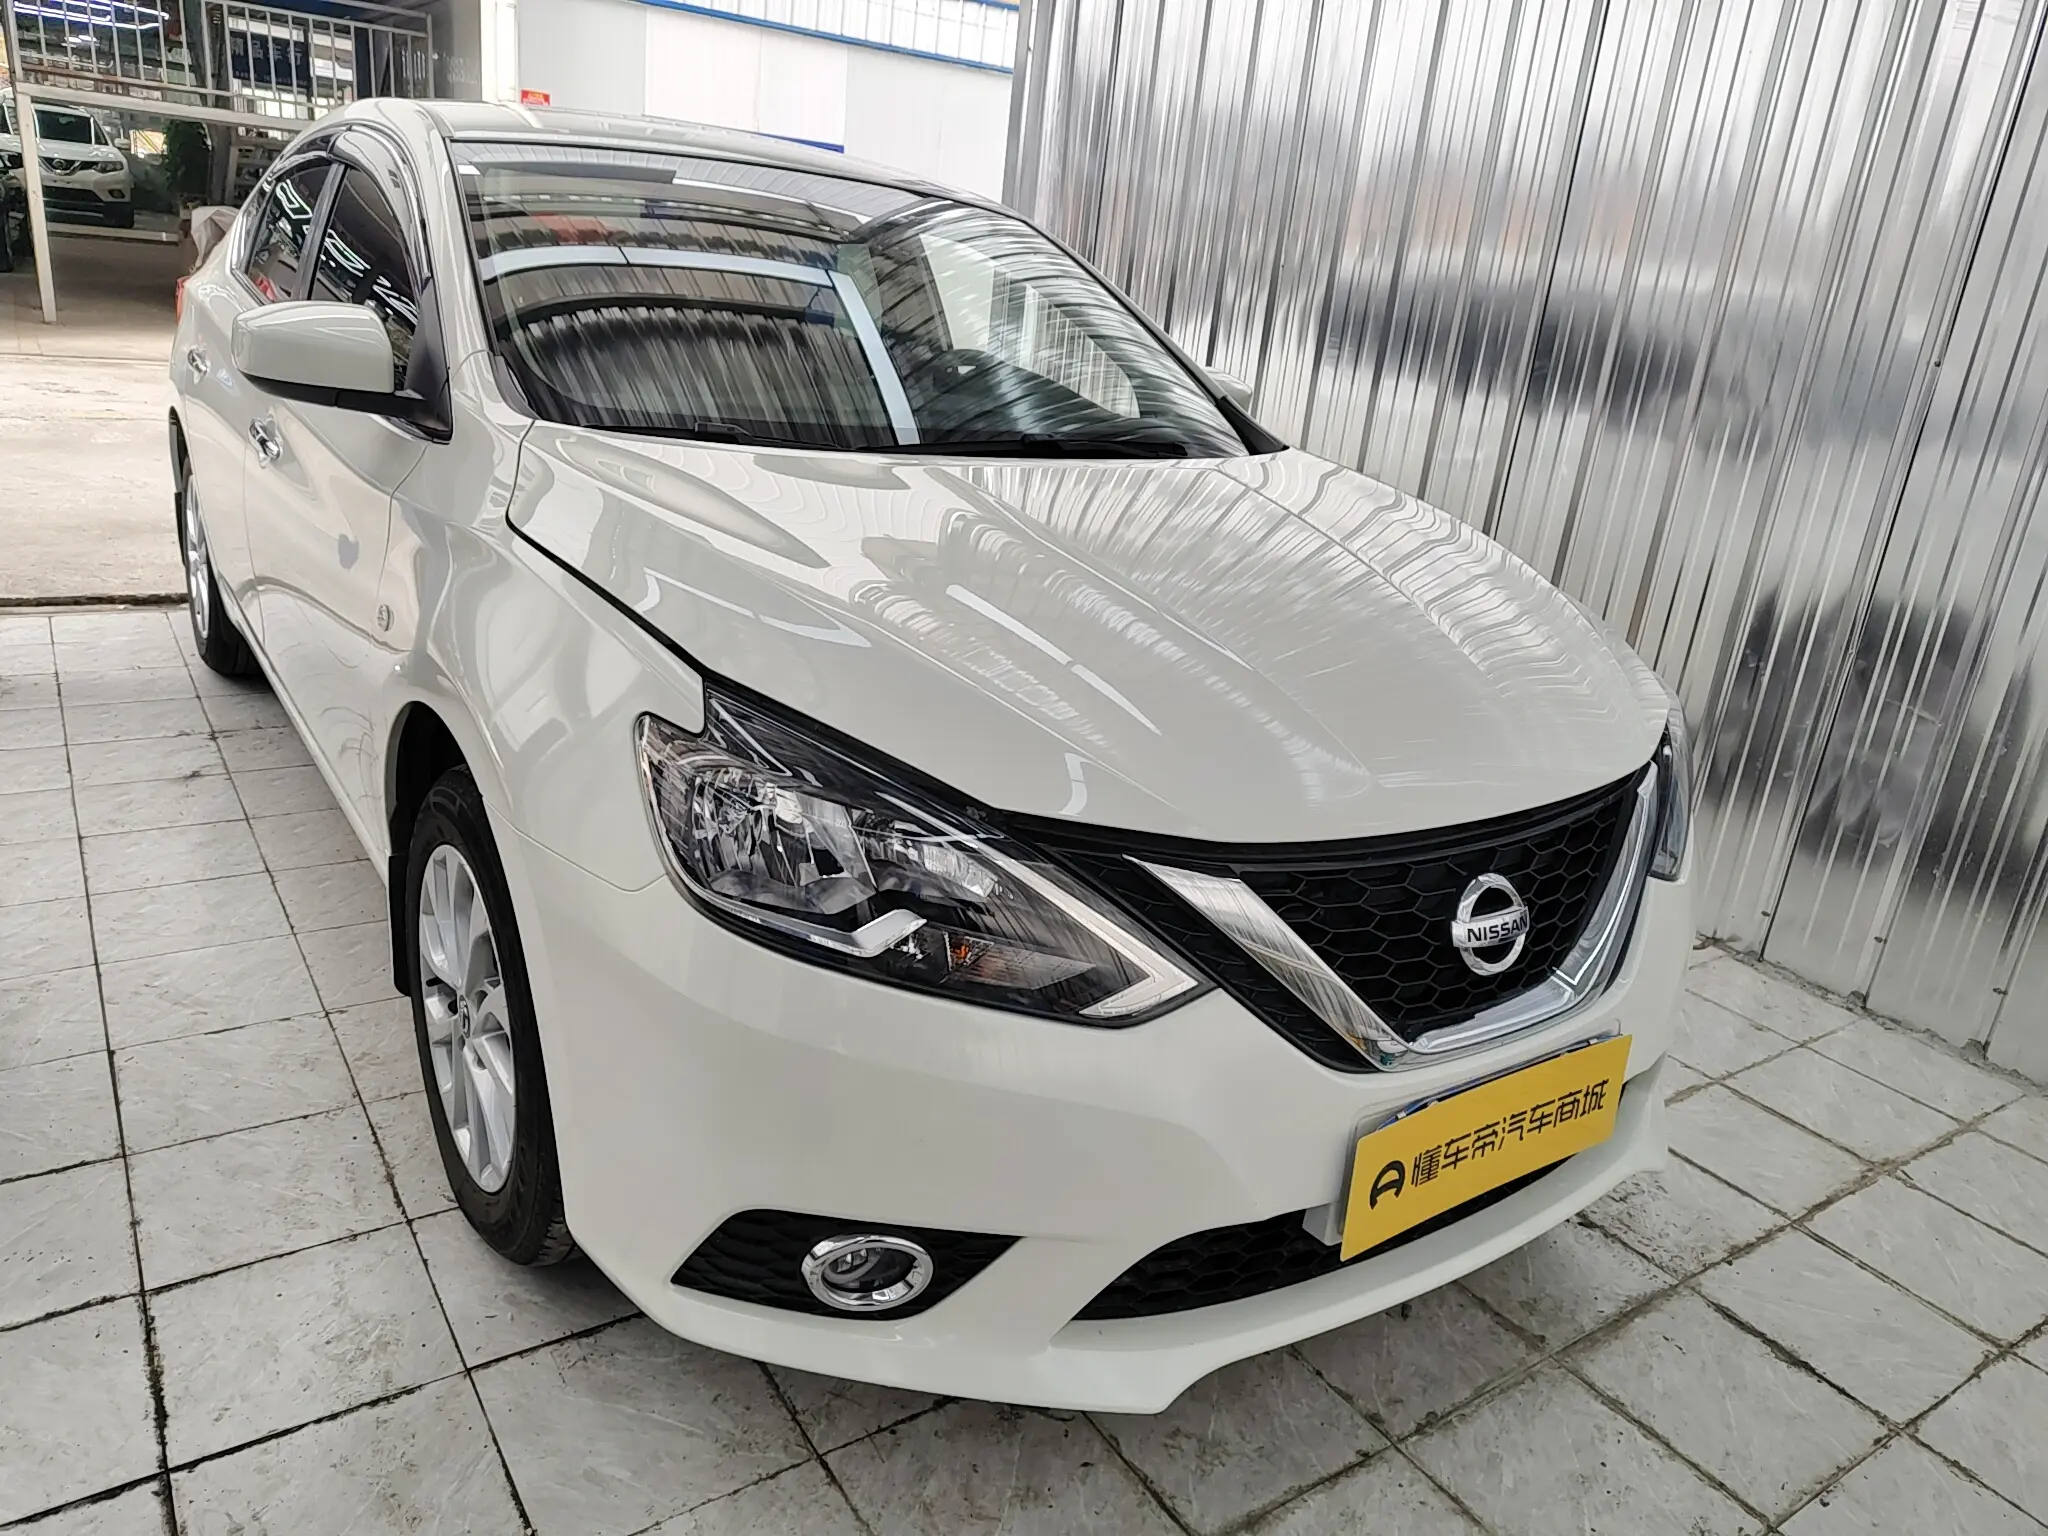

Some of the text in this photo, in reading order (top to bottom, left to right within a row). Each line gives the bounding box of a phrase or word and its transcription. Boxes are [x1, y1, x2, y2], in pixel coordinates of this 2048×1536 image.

[1467, 916, 1528, 942] NISSAN
[1410, 1078, 1609, 1187] 懂车帝汽车商城
